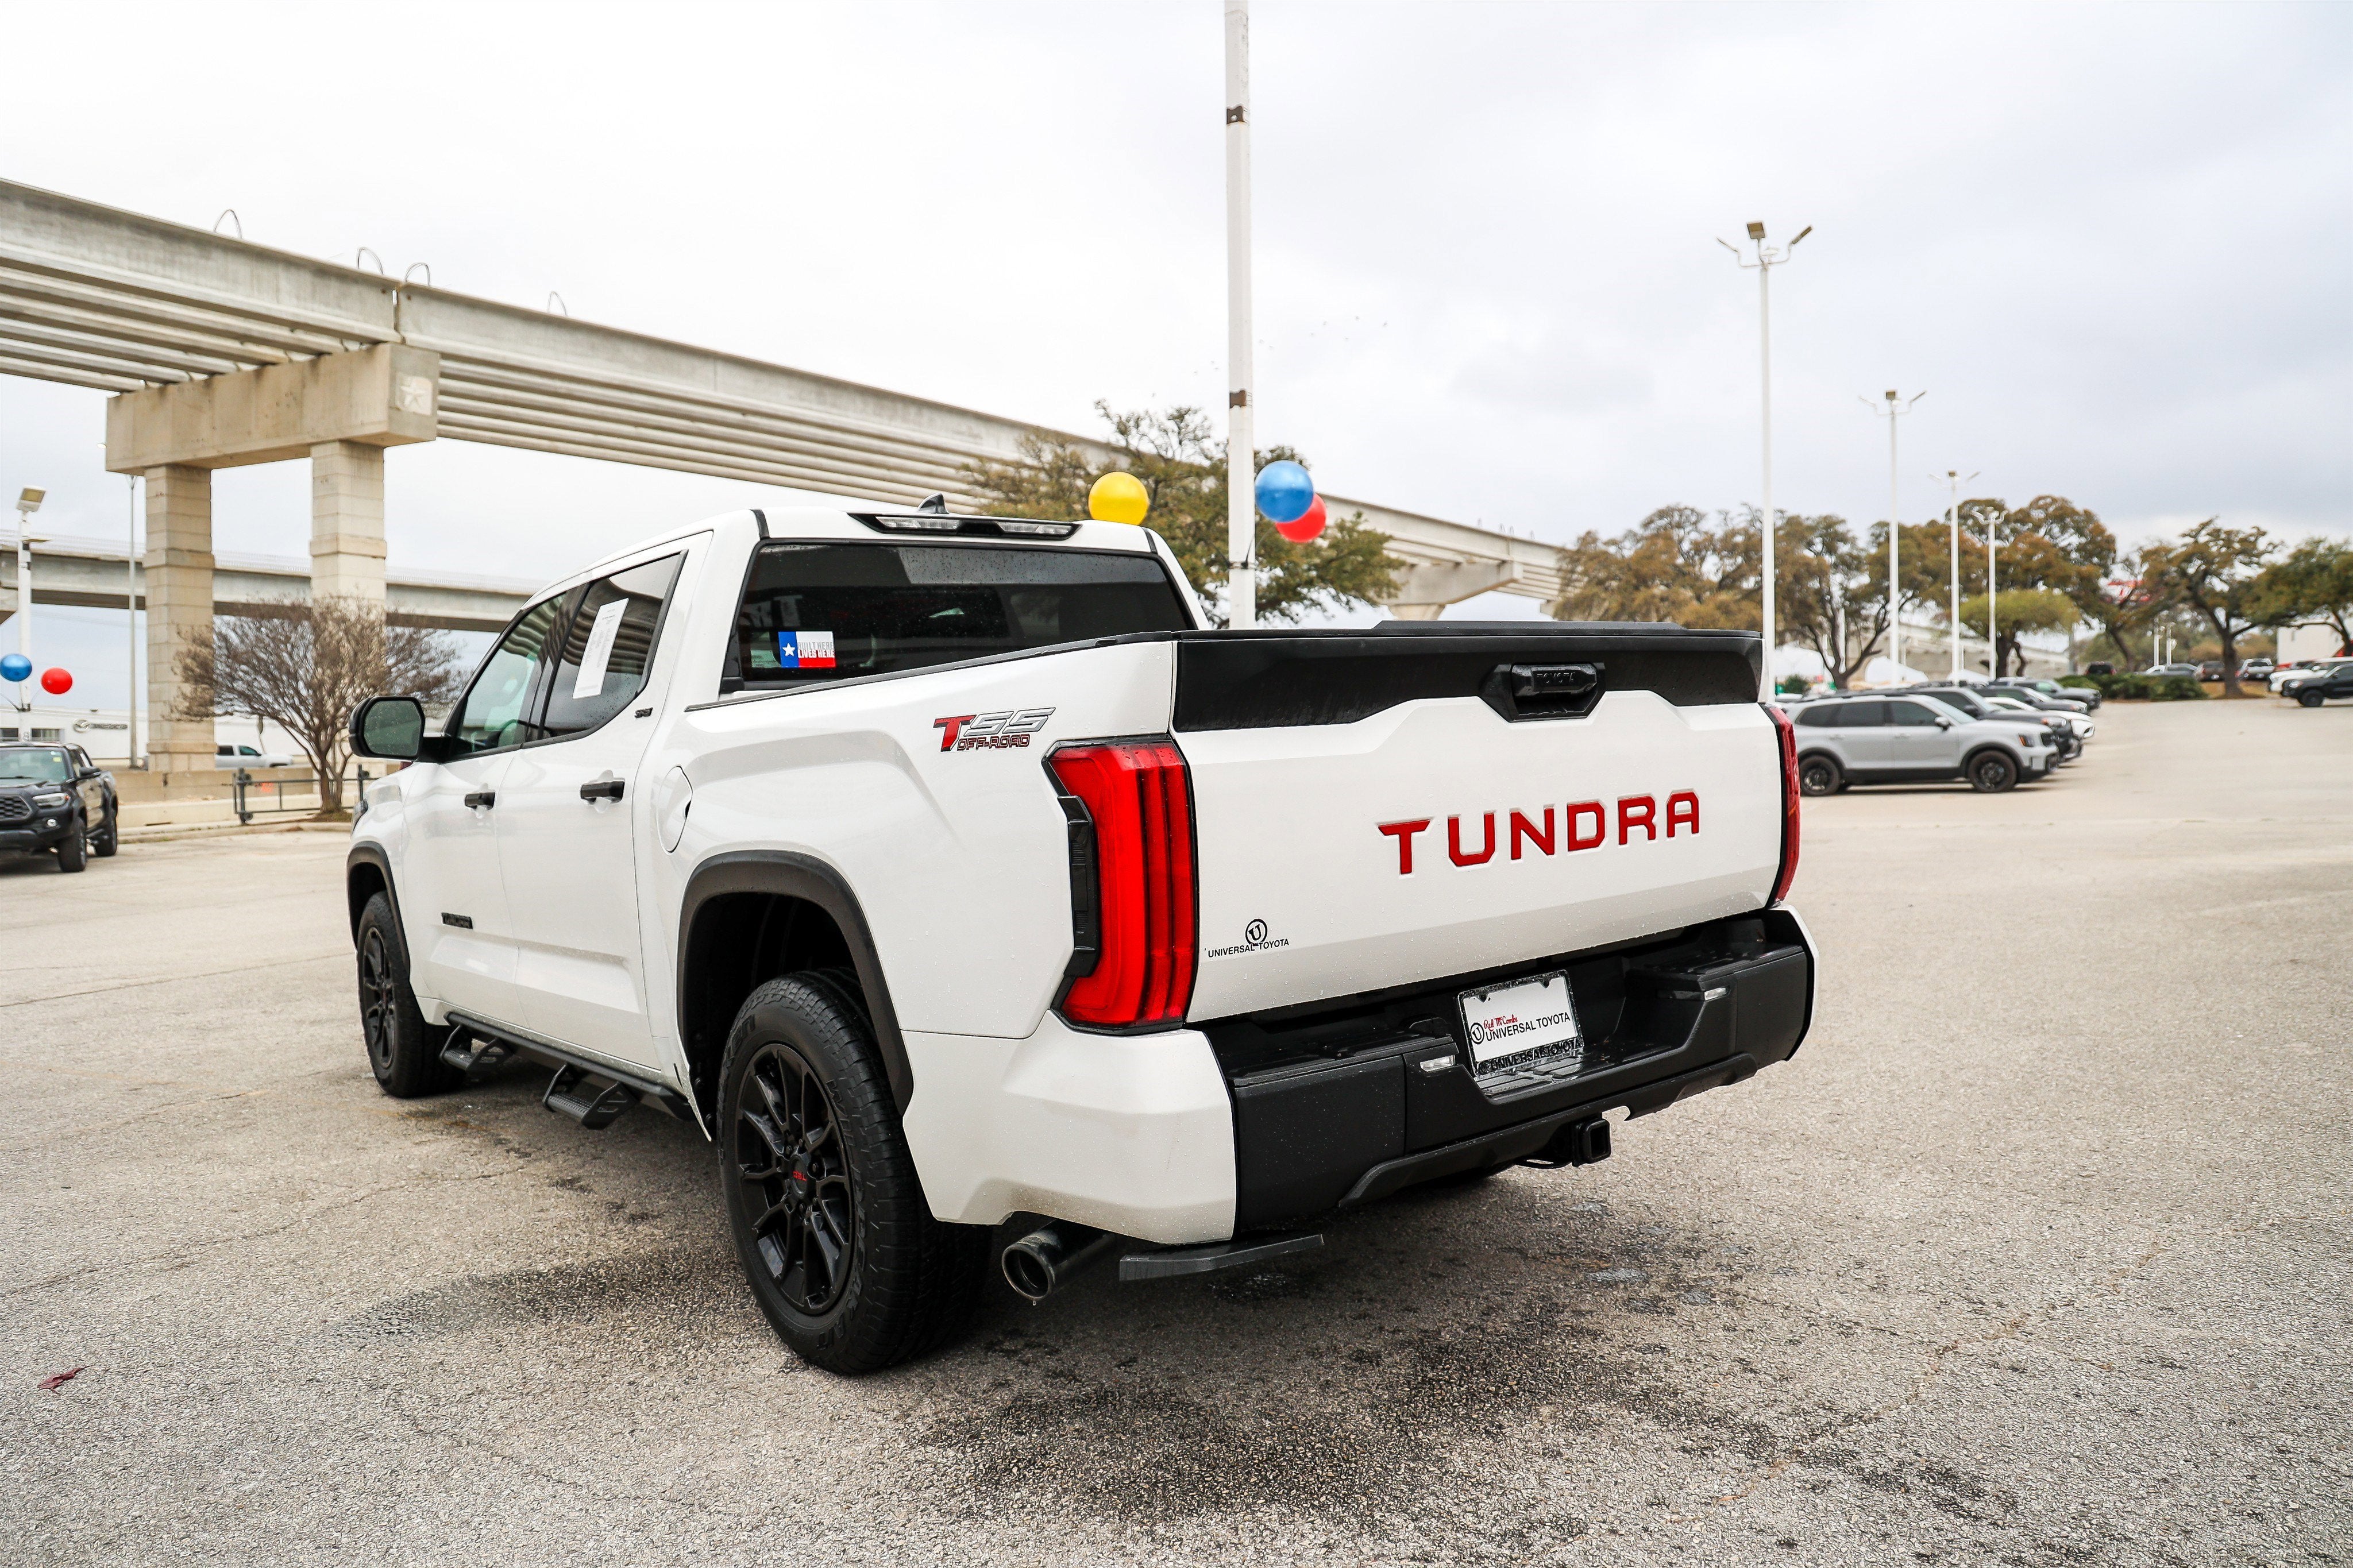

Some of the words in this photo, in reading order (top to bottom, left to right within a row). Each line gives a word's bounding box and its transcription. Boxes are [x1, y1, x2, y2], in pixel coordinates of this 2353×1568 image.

[798, 642, 816, 650] BUILT
[817, 642, 833, 650] HERE
[798, 650, 817, 658] LIVES
[818, 650, 835, 658] HERE
[932, 706, 1056, 752] TSS
[957, 733, 1031, 752] OFF-ROAD
[1378, 790, 1700, 875] TUNDRA
[1208, 944, 1255, 958] UNIVERSAL
[1258, 939, 1290, 951] TOYOTA
[1484, 1018, 1495, 1032] Red
[1486, 1021, 1537, 1041] UNIVERSAL
[1536, 1012, 1571, 1029] TOYOTA
[1491, 1048, 1545, 1070] UNIVERSAL
[1544, 1037, 1582, 1055] TOYOTA
